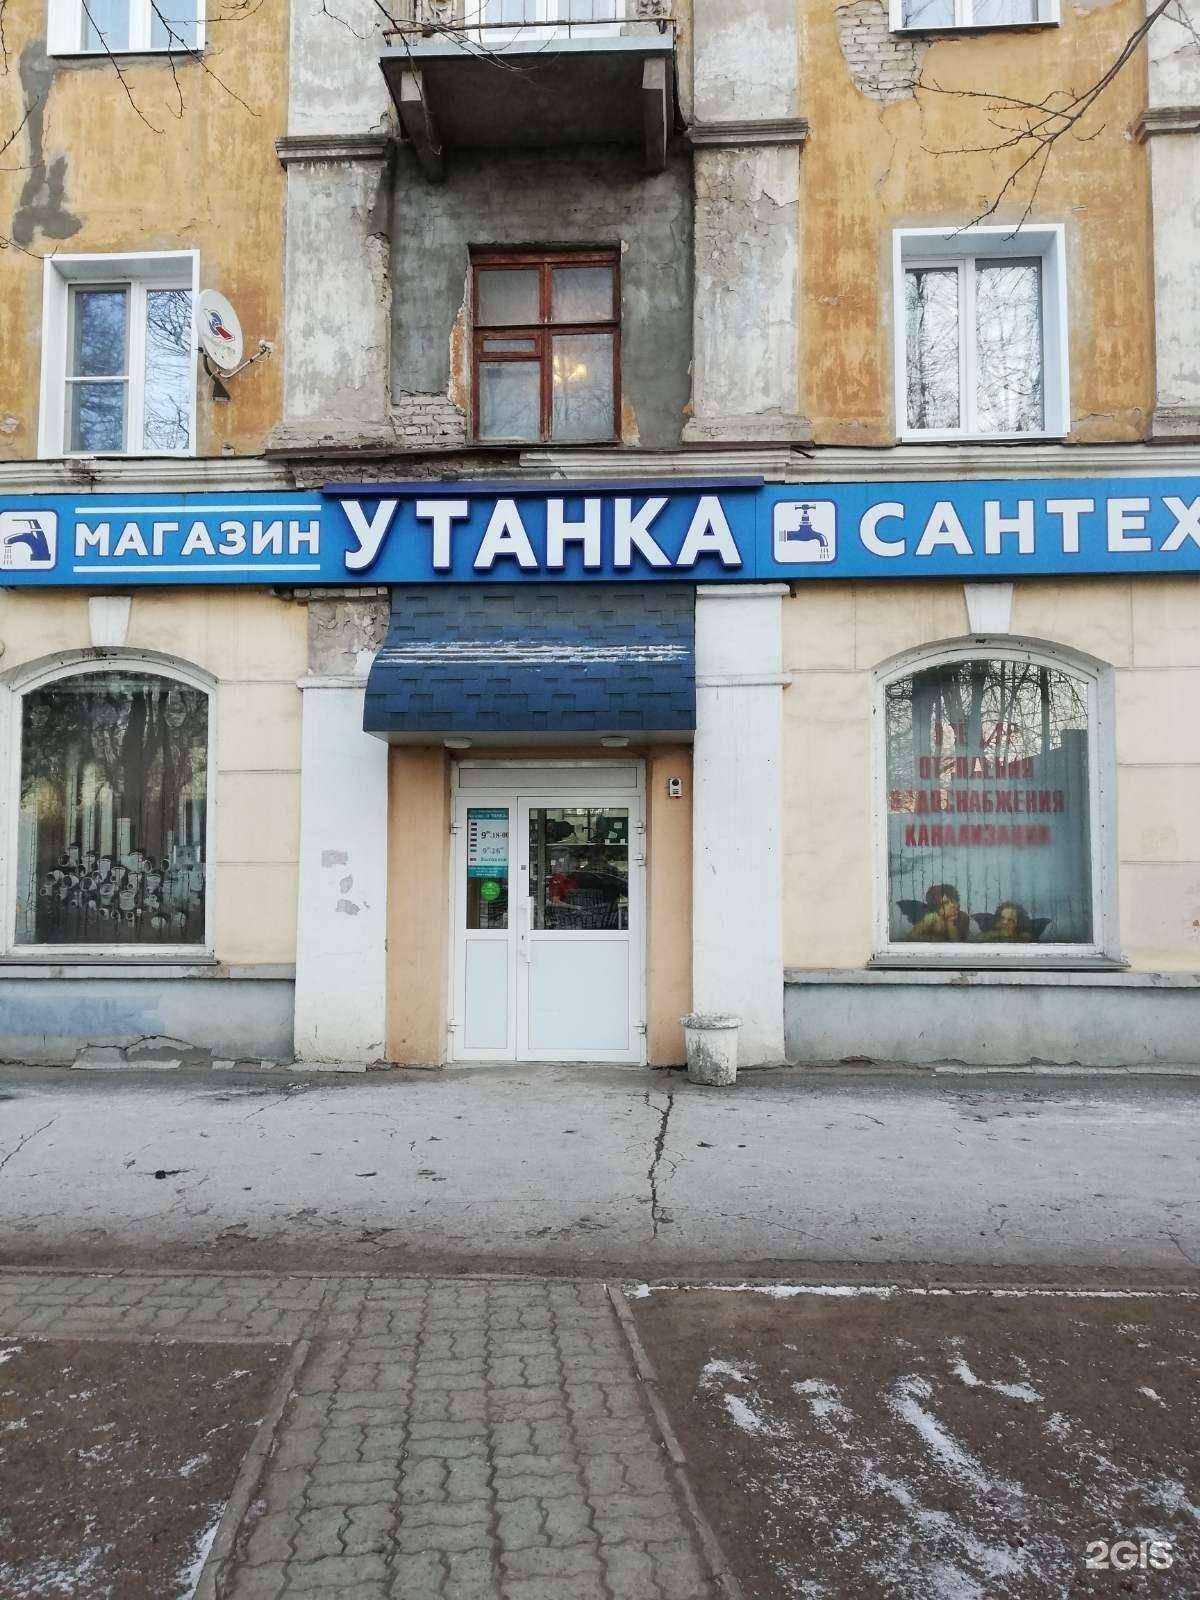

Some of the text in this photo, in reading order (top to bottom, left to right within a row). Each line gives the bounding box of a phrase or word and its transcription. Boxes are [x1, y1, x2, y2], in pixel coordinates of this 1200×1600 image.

[75, 495, 742, 569] МАГАЗИН У ТАНКА
[859, 496, 1200, 557] САНТЕХ
